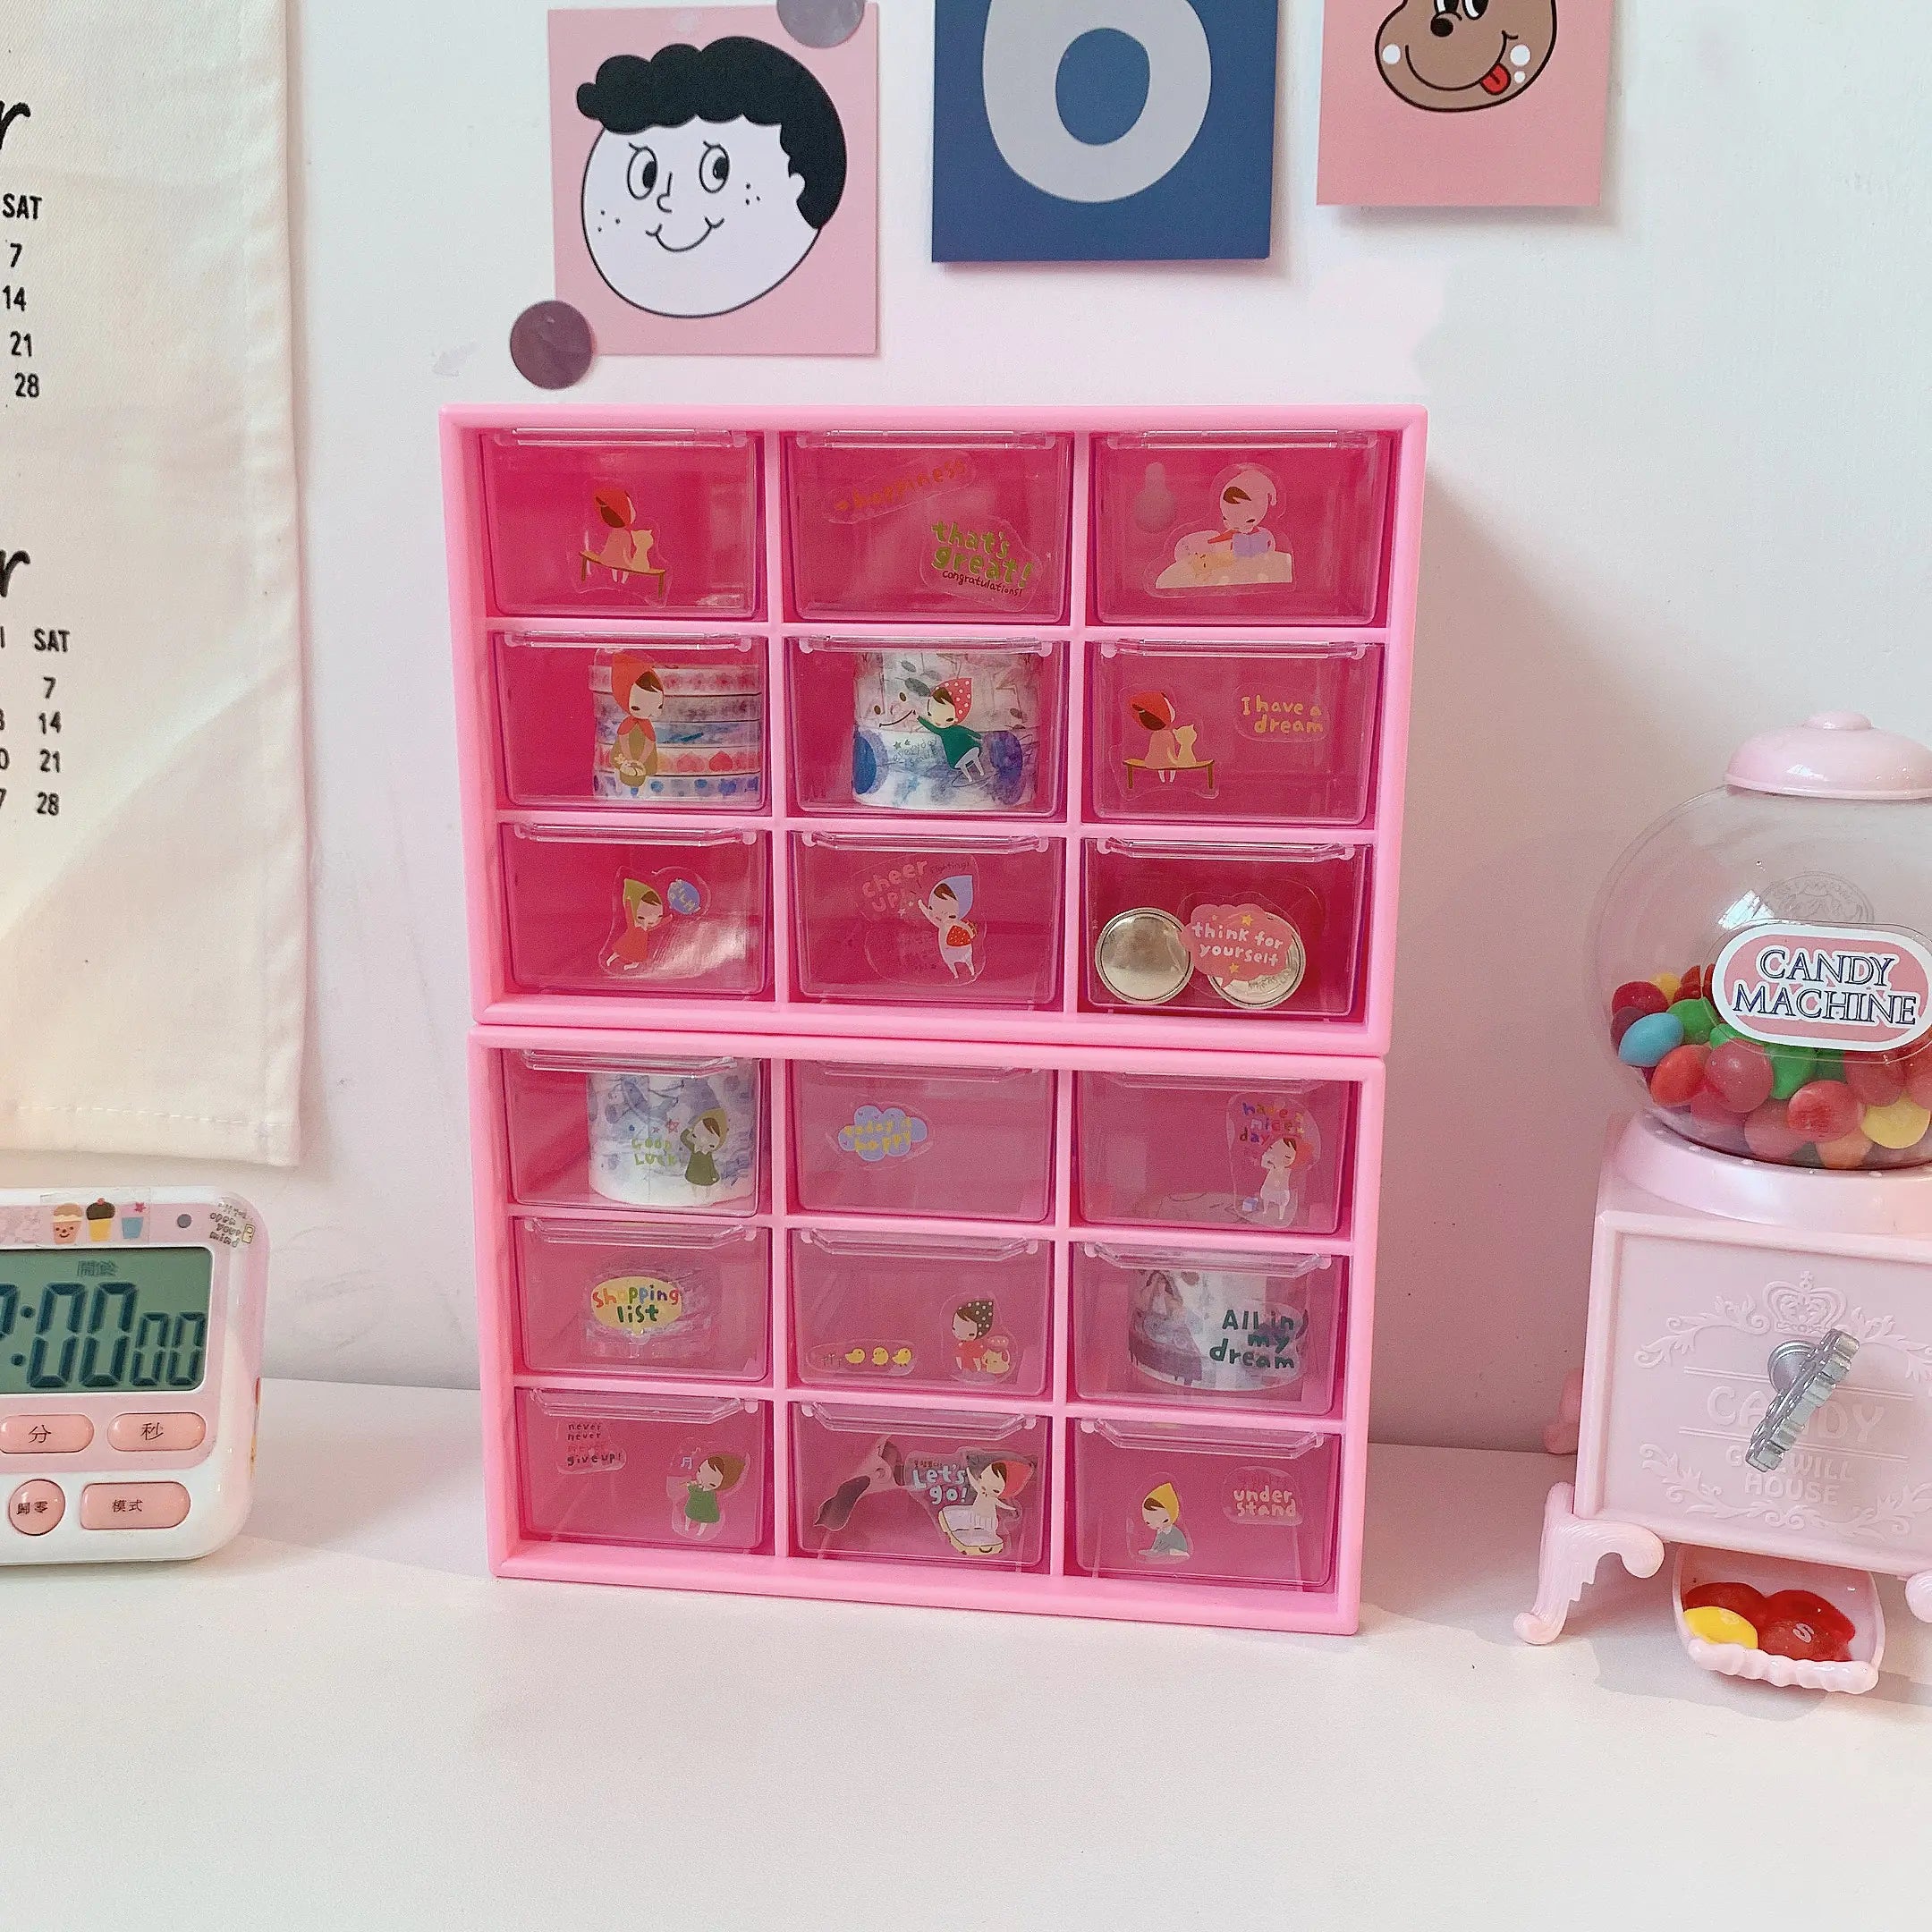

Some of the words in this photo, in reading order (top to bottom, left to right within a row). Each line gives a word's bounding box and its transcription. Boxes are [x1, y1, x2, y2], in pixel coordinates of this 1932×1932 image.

[3, 193, 42, 219] SAT
[10, 243, 22, 267] 7
[3, 285, 26, 311] 14
[10, 331, 32, 357] 21
[15, 373, 40, 397] 28
[931, 521, 1010, 559] that's
[931, 547, 1034, 589] great!
[942, 570, 1023, 597] congratulations!
[34, 628, 70, 652] SAT
[43, 677, 56, 699] 7
[1241, 696, 1250, 716] I
[1256, 694, 1304, 715] have
[1309, 705, 1322, 716] a
[38, 711, 62, 734] 14
[1254, 714, 1324, 733] dream
[39, 749, 61, 773] 21
[37, 792, 60, 816] 28
[861, 860, 928, 898] cheer
[1191, 921, 1250, 942] think
[1254, 930, 1284, 949] for
[1199, 943, 1279, 967] yourself
[1759, 949, 1894, 987] CANDY
[1733, 984, 1917, 1025] MACHINE
[1240, 1127, 1270, 1145] day
[592, 1284, 679, 1308] shopping
[617, 1304, 659, 1323] list
[1222, 1309, 1259, 1330] All
[1271, 1309, 1294, 1330] in
[1209, 1338, 1294, 1368] dream
[1247, 1334, 1290, 1353] my
[1707, 1385, 1885, 1443] CADY
[29, 1424, 52, 1444] 分
[140, 1422, 165, 1441] 秒
[567, 1433, 601, 1441] never
[912, 1463, 967, 1490] Let's
[1745, 1472, 1840, 1504] HOUSE
[112, 1499, 144, 1513] 模式
[928, 1486, 969, 1505] go!
[1233, 1485, 1293, 1503] under
[1236, 1498, 1297, 1517] stand
